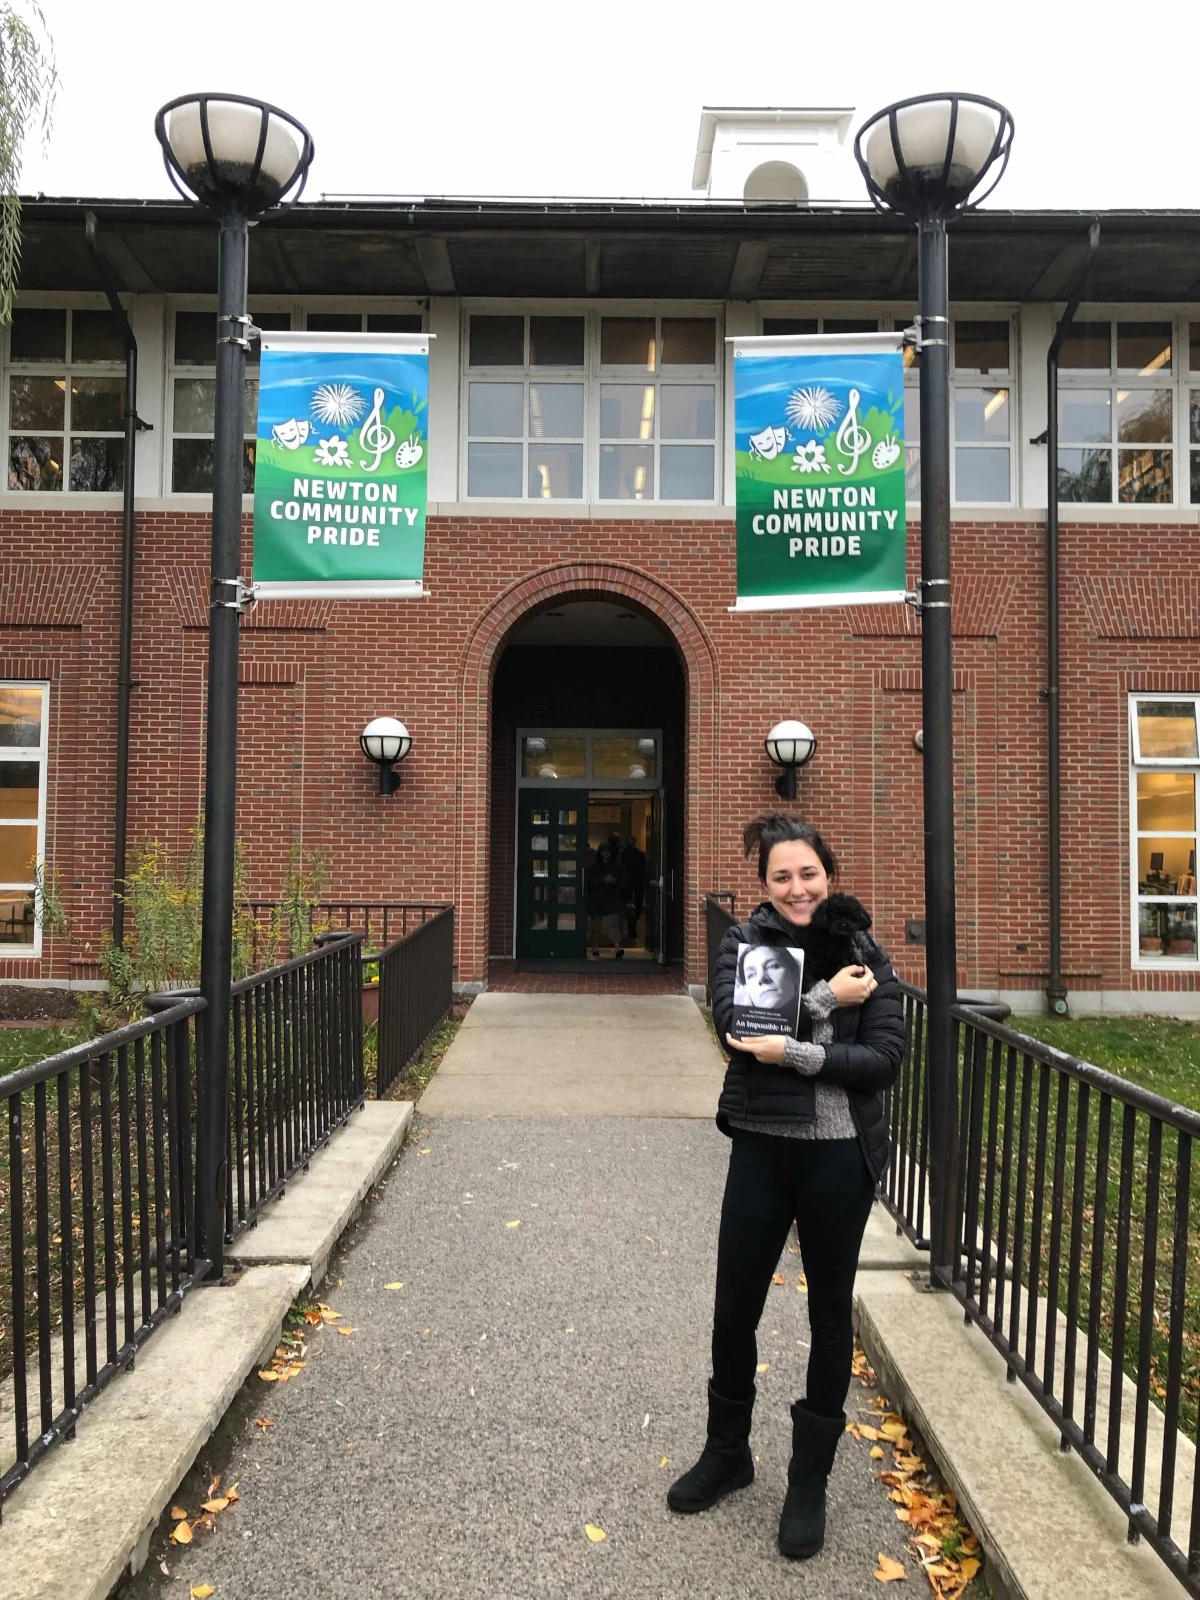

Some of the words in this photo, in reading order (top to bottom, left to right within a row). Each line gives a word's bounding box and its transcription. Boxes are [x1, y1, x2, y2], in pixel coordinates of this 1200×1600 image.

[293, 478, 397, 503] NEWTON
[773, 486, 876, 510] NEWTON
[270, 500, 419, 526] COMMUNITY
[752, 509, 898, 535] COMMUNITY
[307, 526, 380, 547] PRIDE
[789, 535, 861, 558] PRIDE
[736, 1019, 746, 1027] An
[746, 1020, 779, 1031] Impossible
[780, 1024, 792, 1033] Life
